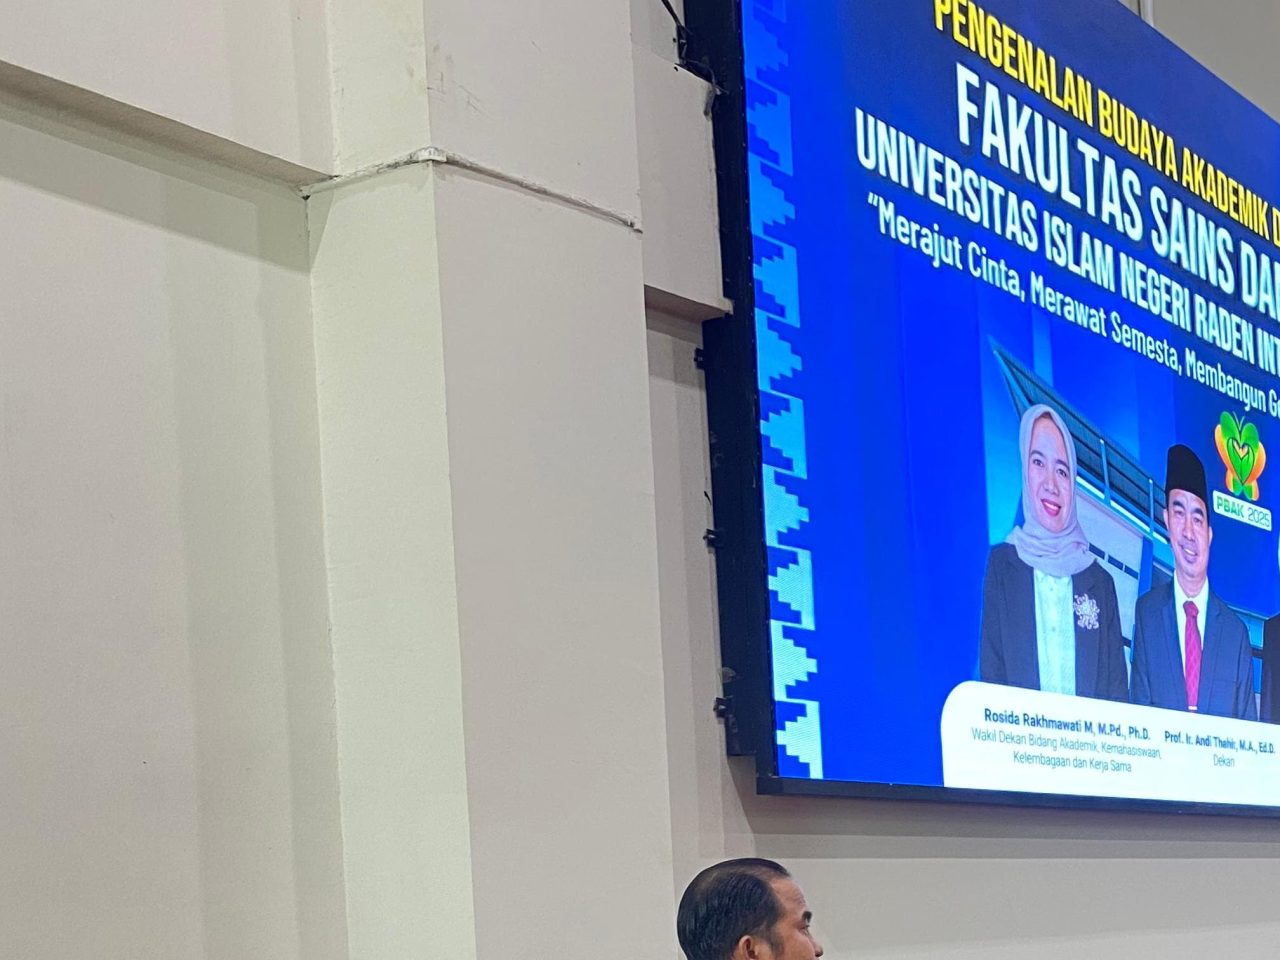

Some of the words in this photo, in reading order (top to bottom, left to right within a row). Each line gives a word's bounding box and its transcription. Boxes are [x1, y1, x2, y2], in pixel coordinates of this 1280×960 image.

[935, 0, 1093, 127] PENGENALAN
[1098, 88, 1178, 182] BUDAYA
[1182, 147, 1270, 240] AKADEMIK
[956, 62, 1143, 241] FAKULTAS
[1150, 186, 1235, 294] SAINS
[855, 106, 1038, 252] UNIVERSITAS
[1043, 210, 1115, 293] ISLAM
[1119, 252, 1191, 333] NEGERI
[1194, 294, 1255, 365] RADEN
[968, 241, 1025, 302] Cinta,
[1030, 271, 1107, 338] Merawat
[1110, 311, 1182, 376] Semesta,
[1185, 347, 1267, 412] Membangun
[1216, 495, 1244, 519] PBAK
[1247, 506, 1270, 528] 2025
[971, 727, 997, 743] Wakil
[999, 731, 1027, 745] Dekan
[1029, 734, 1058, 752] Bidang
[984, 708, 1020, 726] Rosida
[1023, 713, 1082, 733] Rakhmawati
[1098, 723, 1126, 740] M.Pd.,
[1128, 727, 1151, 741] Ph.D.
[1165, 730, 1184, 744] Prof.
[1186, 733, 1194, 745] Ir.
[1195, 735, 1212, 747] Andi
[1259, 742, 1275, 754] Ed.D.
[1013, 751, 1071, 770] Kelembagaan
[1073, 755, 1087, 768] dan
[1089, 757, 1108, 774] Kerja
[1110, 760, 1132, 773] Sama
[1213, 754, 1235, 768] Dekan
